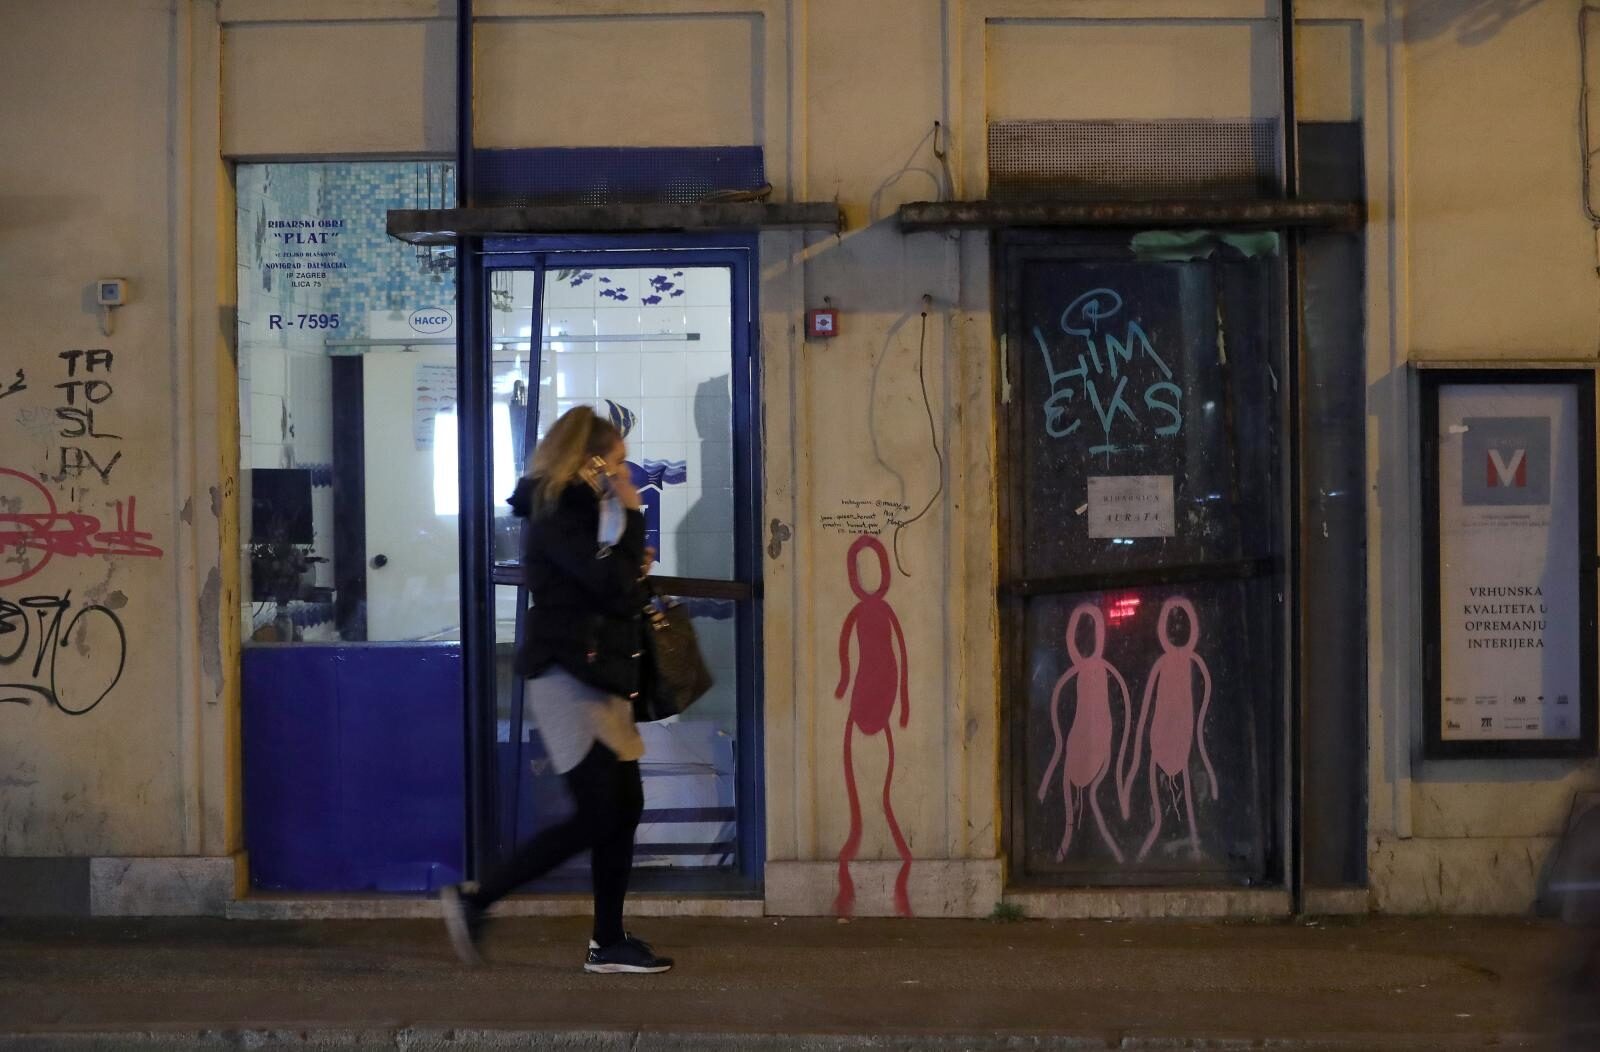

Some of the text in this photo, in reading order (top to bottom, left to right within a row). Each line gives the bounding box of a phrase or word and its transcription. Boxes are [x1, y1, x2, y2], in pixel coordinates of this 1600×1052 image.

[268, 220, 344, 228] RIBARSKI OBRT
[269, 315, 283, 329] R
[298, 314, 340, 329] 7595
[414, 316, 448, 325] HACCP
[1469, 586, 1543, 597] VRHUNSKA
[1463, 604, 1548, 615] KVALITETA U
[1465, 621, 1547, 631] OPREMANJU
[1468, 638, 1545, 650] INTERIJERA
